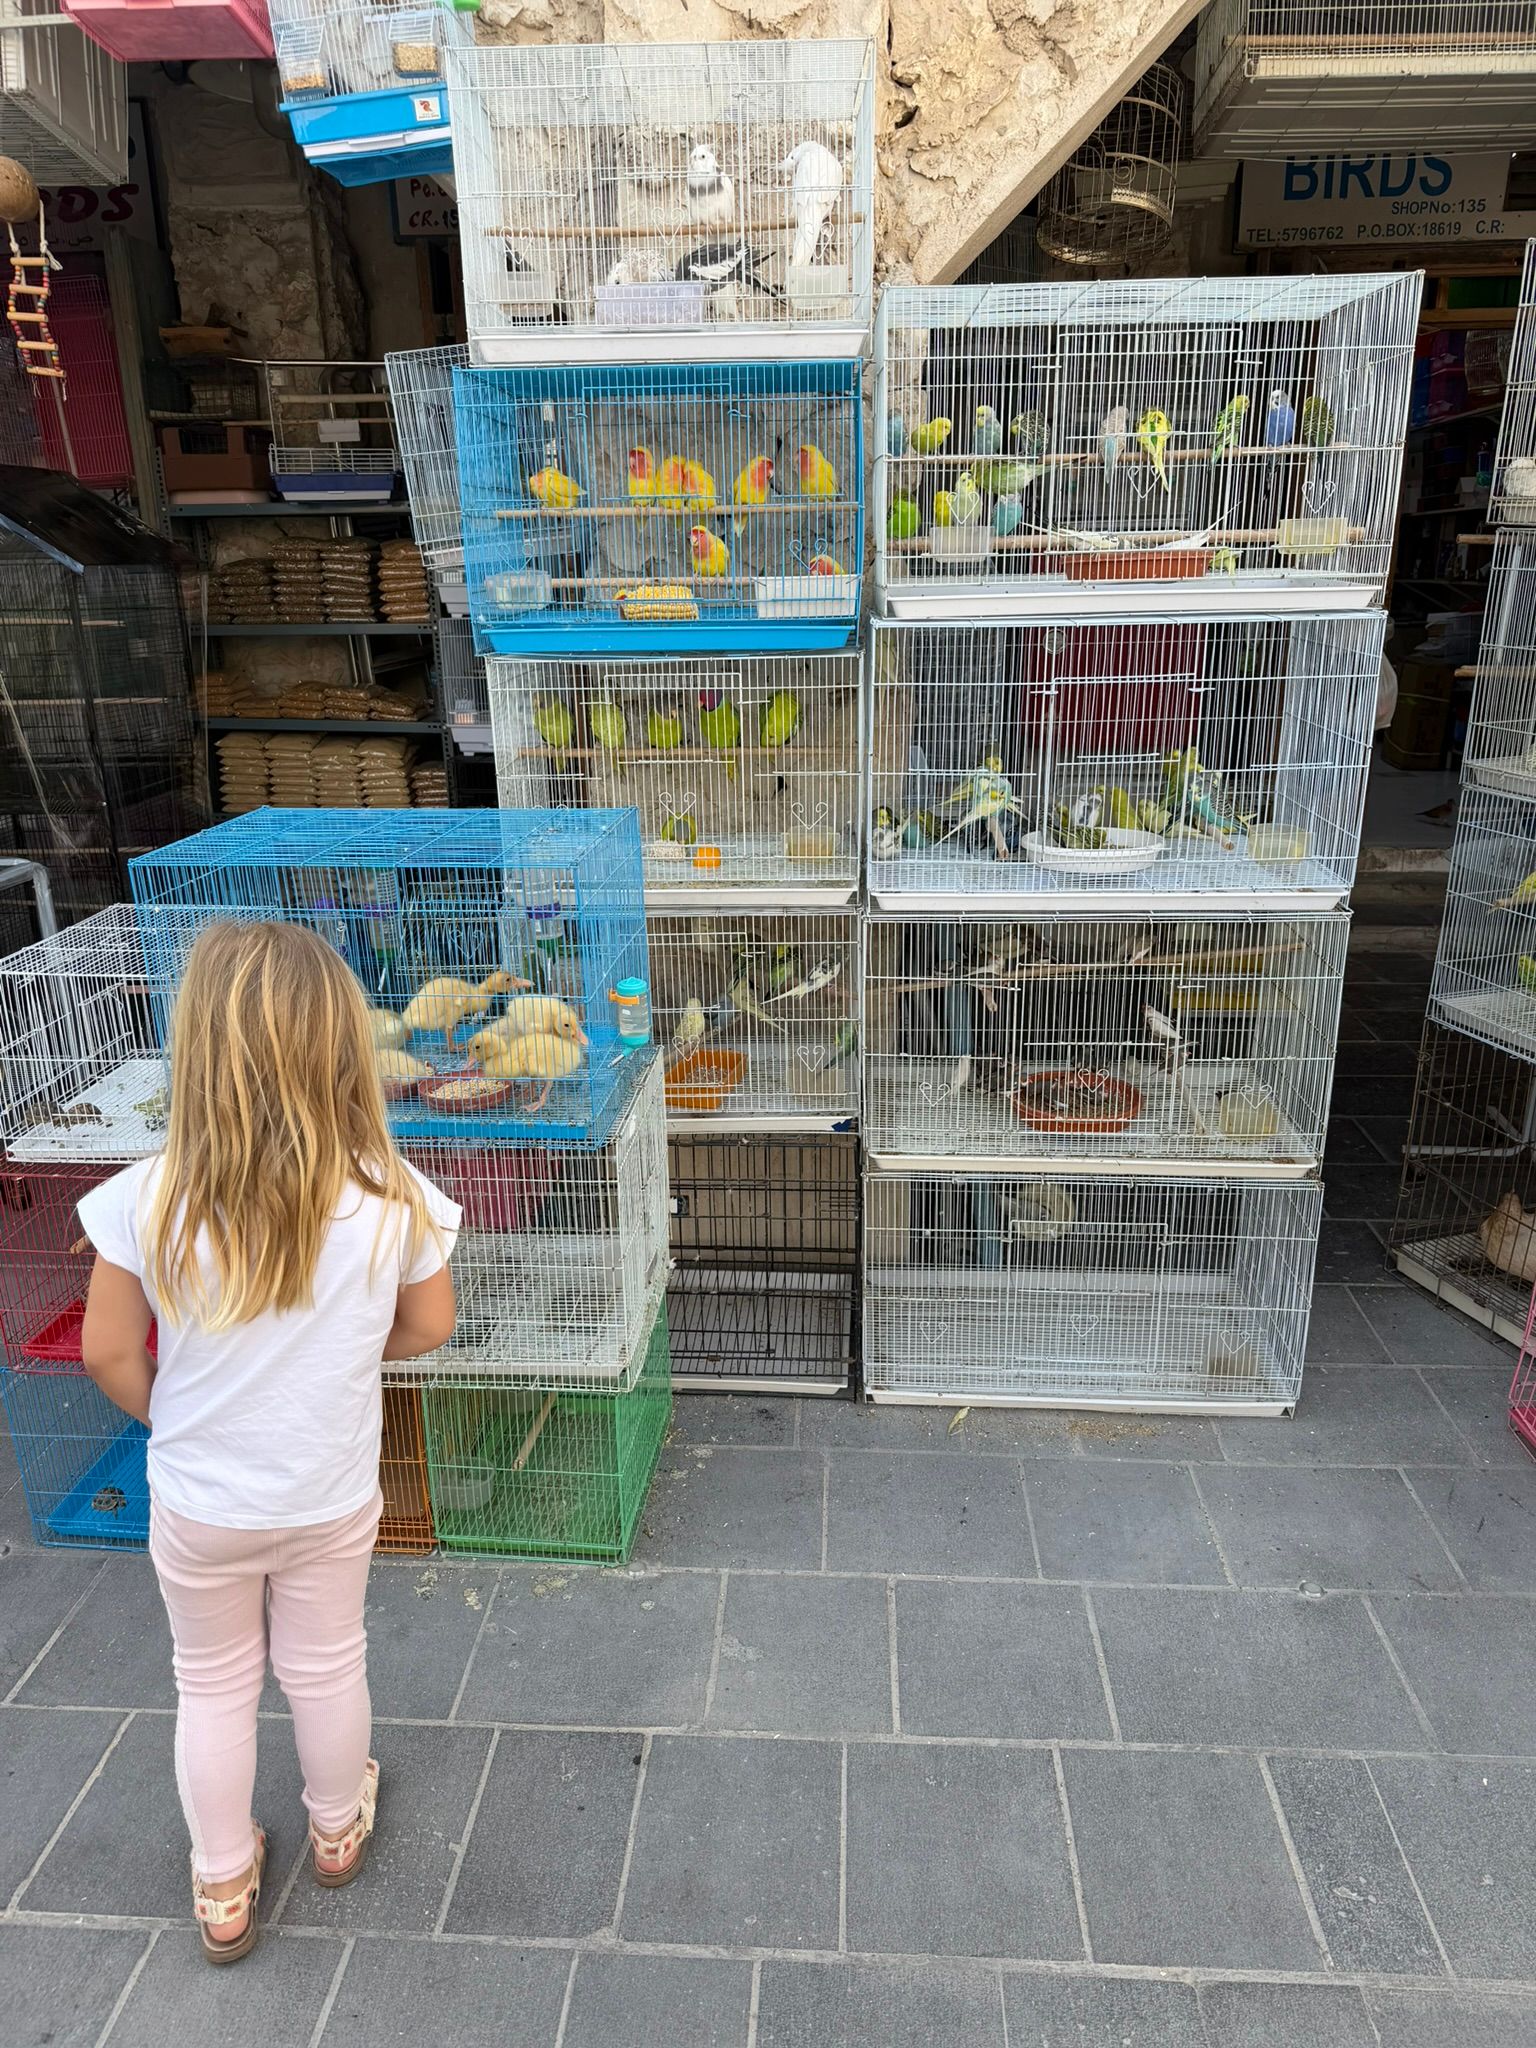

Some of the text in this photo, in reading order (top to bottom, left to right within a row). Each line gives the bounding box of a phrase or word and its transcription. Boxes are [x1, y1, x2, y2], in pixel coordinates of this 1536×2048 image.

[1284, 152, 1454, 200] BIRDS
[1246, 226, 1344, 243] TEL:5796762
[1357, 222, 1462, 239] P.O.BOX:18619
